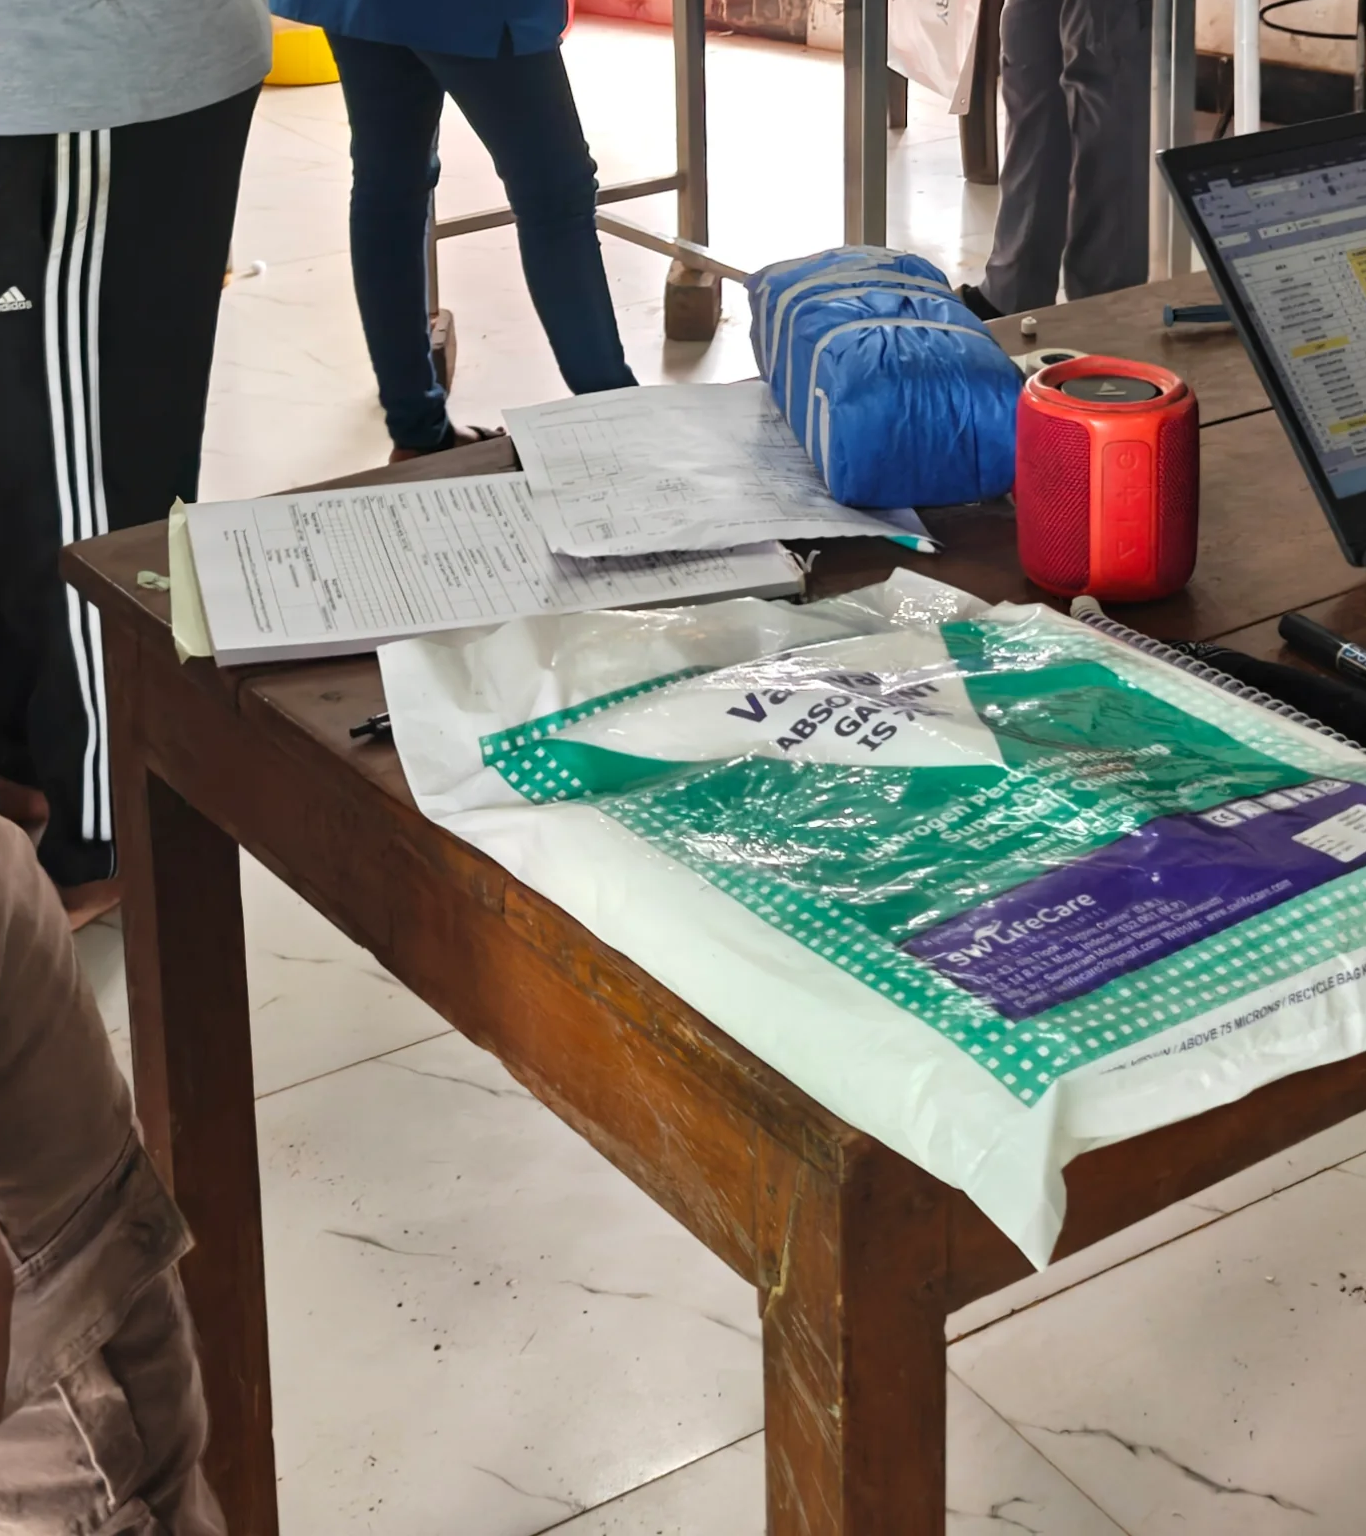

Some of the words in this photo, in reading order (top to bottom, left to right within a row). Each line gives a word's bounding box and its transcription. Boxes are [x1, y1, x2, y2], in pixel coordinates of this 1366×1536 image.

[1178, 1027, 1219, 1054] ABOVE
[1234, 999, 1280, 1030] MICRONS
[1287, 975, 1335, 1006] RECYCLE
[1336, 967, 1361, 986] BAG
